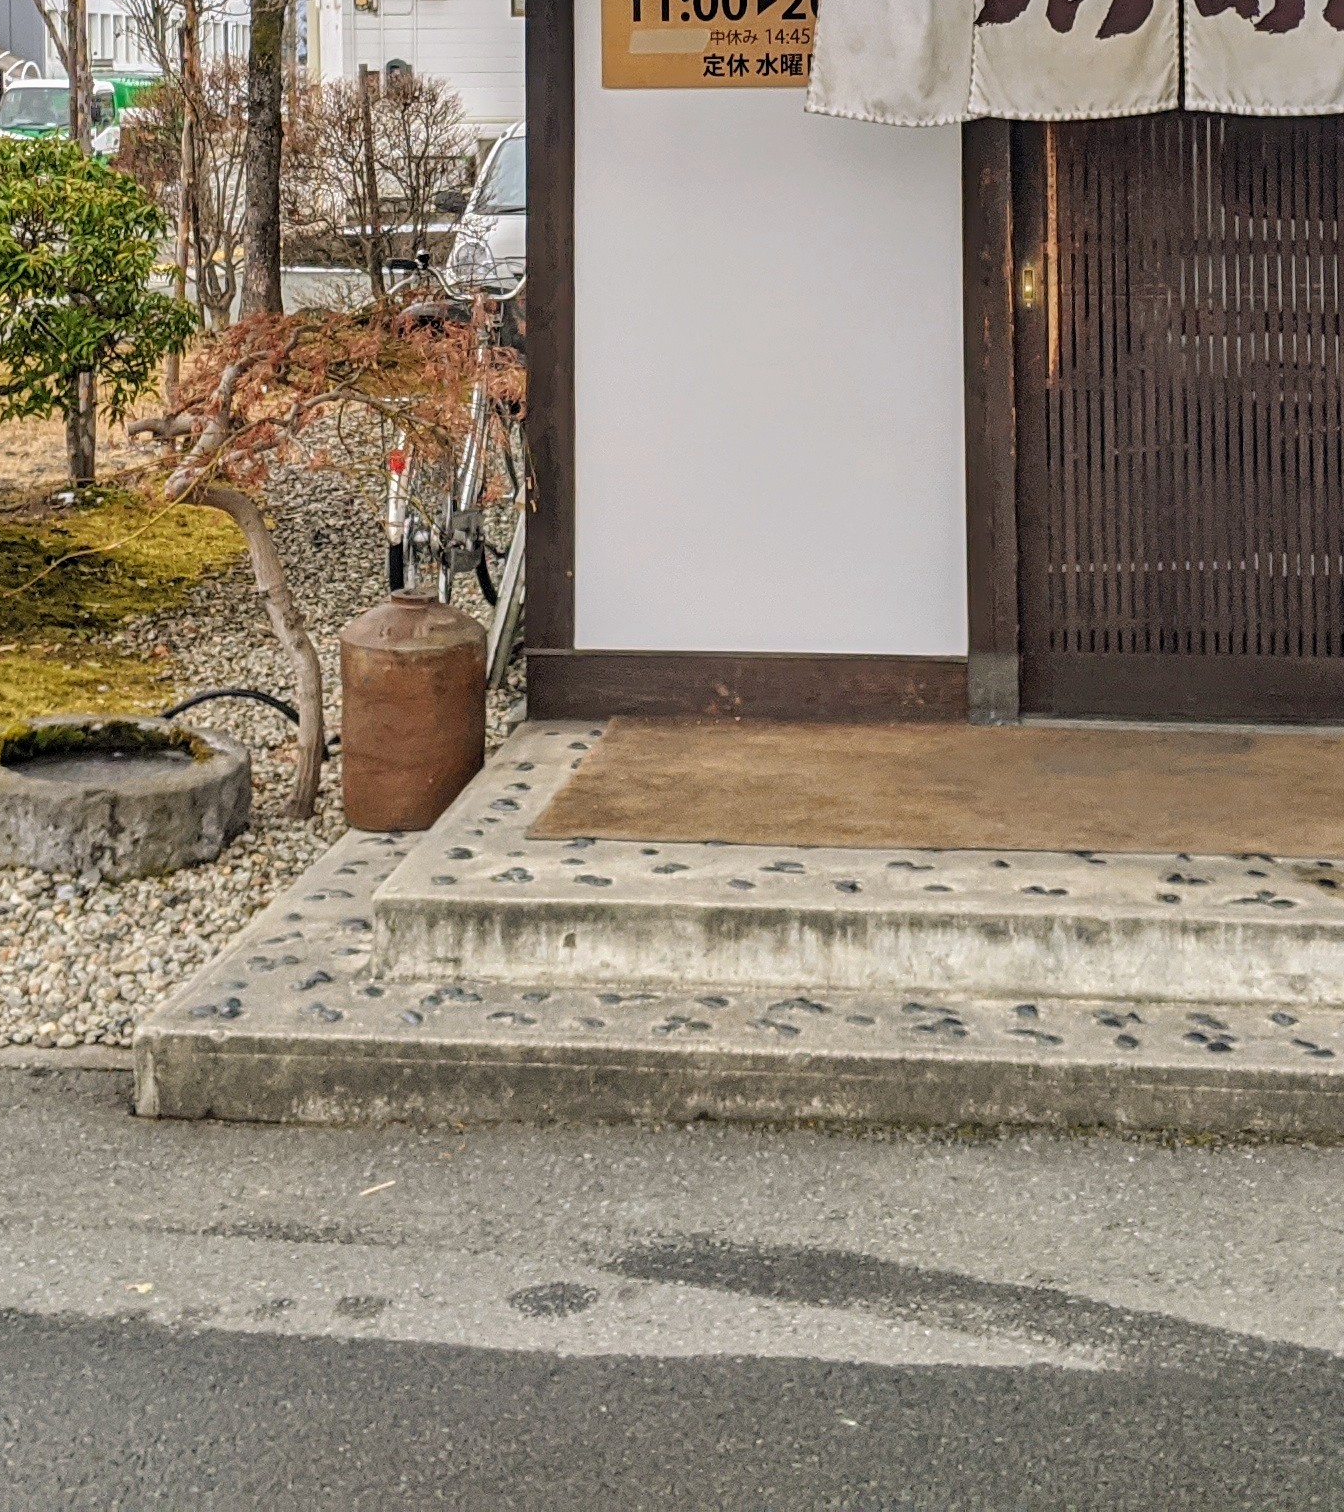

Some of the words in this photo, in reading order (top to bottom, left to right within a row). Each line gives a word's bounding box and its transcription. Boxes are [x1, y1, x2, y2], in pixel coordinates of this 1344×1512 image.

[710, 28, 758, 45] 中休み
[765, 28, 811, 45] 14:45
[703, 53, 750, 78] 定休
